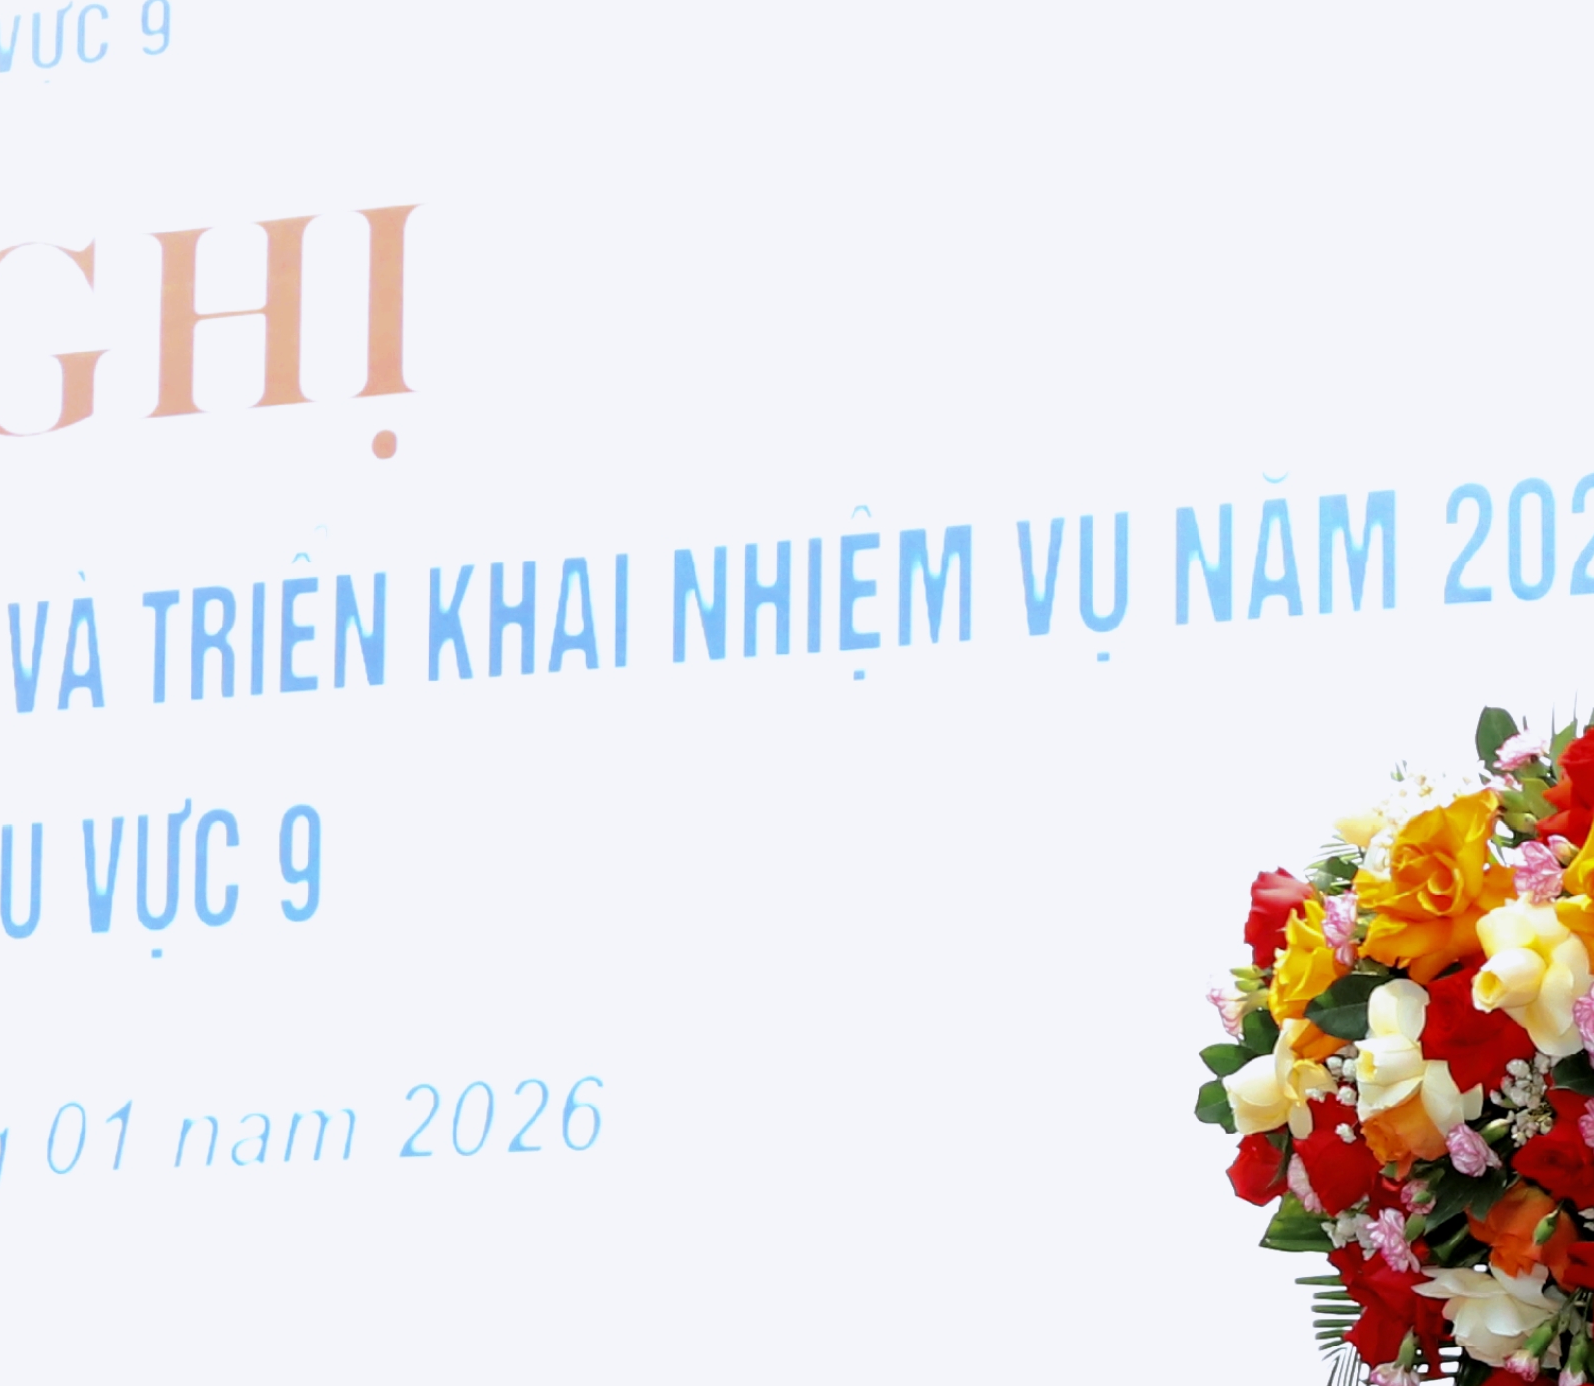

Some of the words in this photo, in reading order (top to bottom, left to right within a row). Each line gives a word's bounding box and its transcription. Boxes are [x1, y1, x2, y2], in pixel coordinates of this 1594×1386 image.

[7, 569, 106, 715] VÀ
[427, 552, 630, 682] KHAI
[672, 504, 974, 681] NHIỆM
[1016, 511, 1131, 663] VỤ
[1175, 472, 1398, 626] NĂM
[81, 797, 240, 960] VỰC
[279, 803, 323, 923] 9
[47, 1099, 133, 1175] 01
[398, 1075, 604, 1158] 2026
